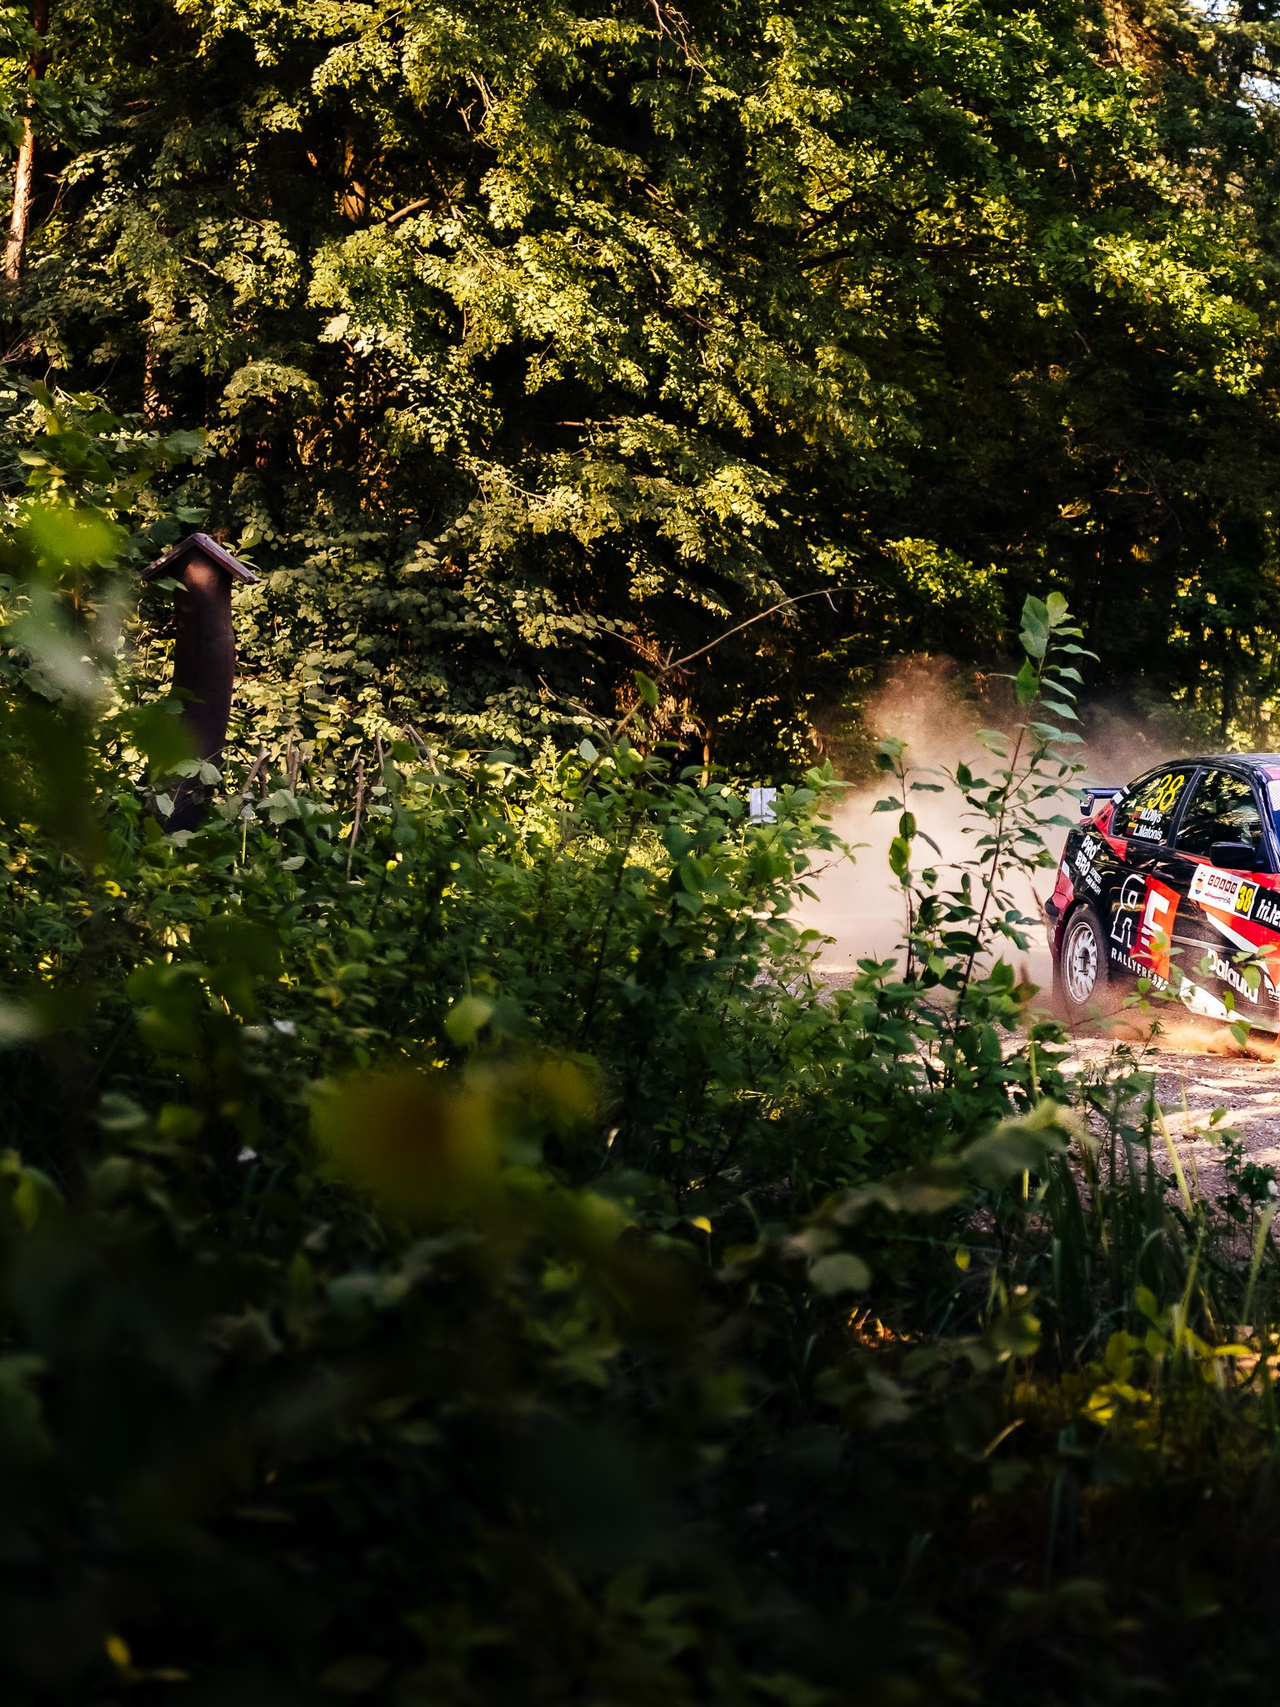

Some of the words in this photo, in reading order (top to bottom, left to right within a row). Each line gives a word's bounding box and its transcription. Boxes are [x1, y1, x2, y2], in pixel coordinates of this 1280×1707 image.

[1148, 774, 1185, 811] 38
[1081, 834, 1097, 860] PRO
[1075, 850, 1091, 876] BRO
[1235, 885, 1254, 913] 38
